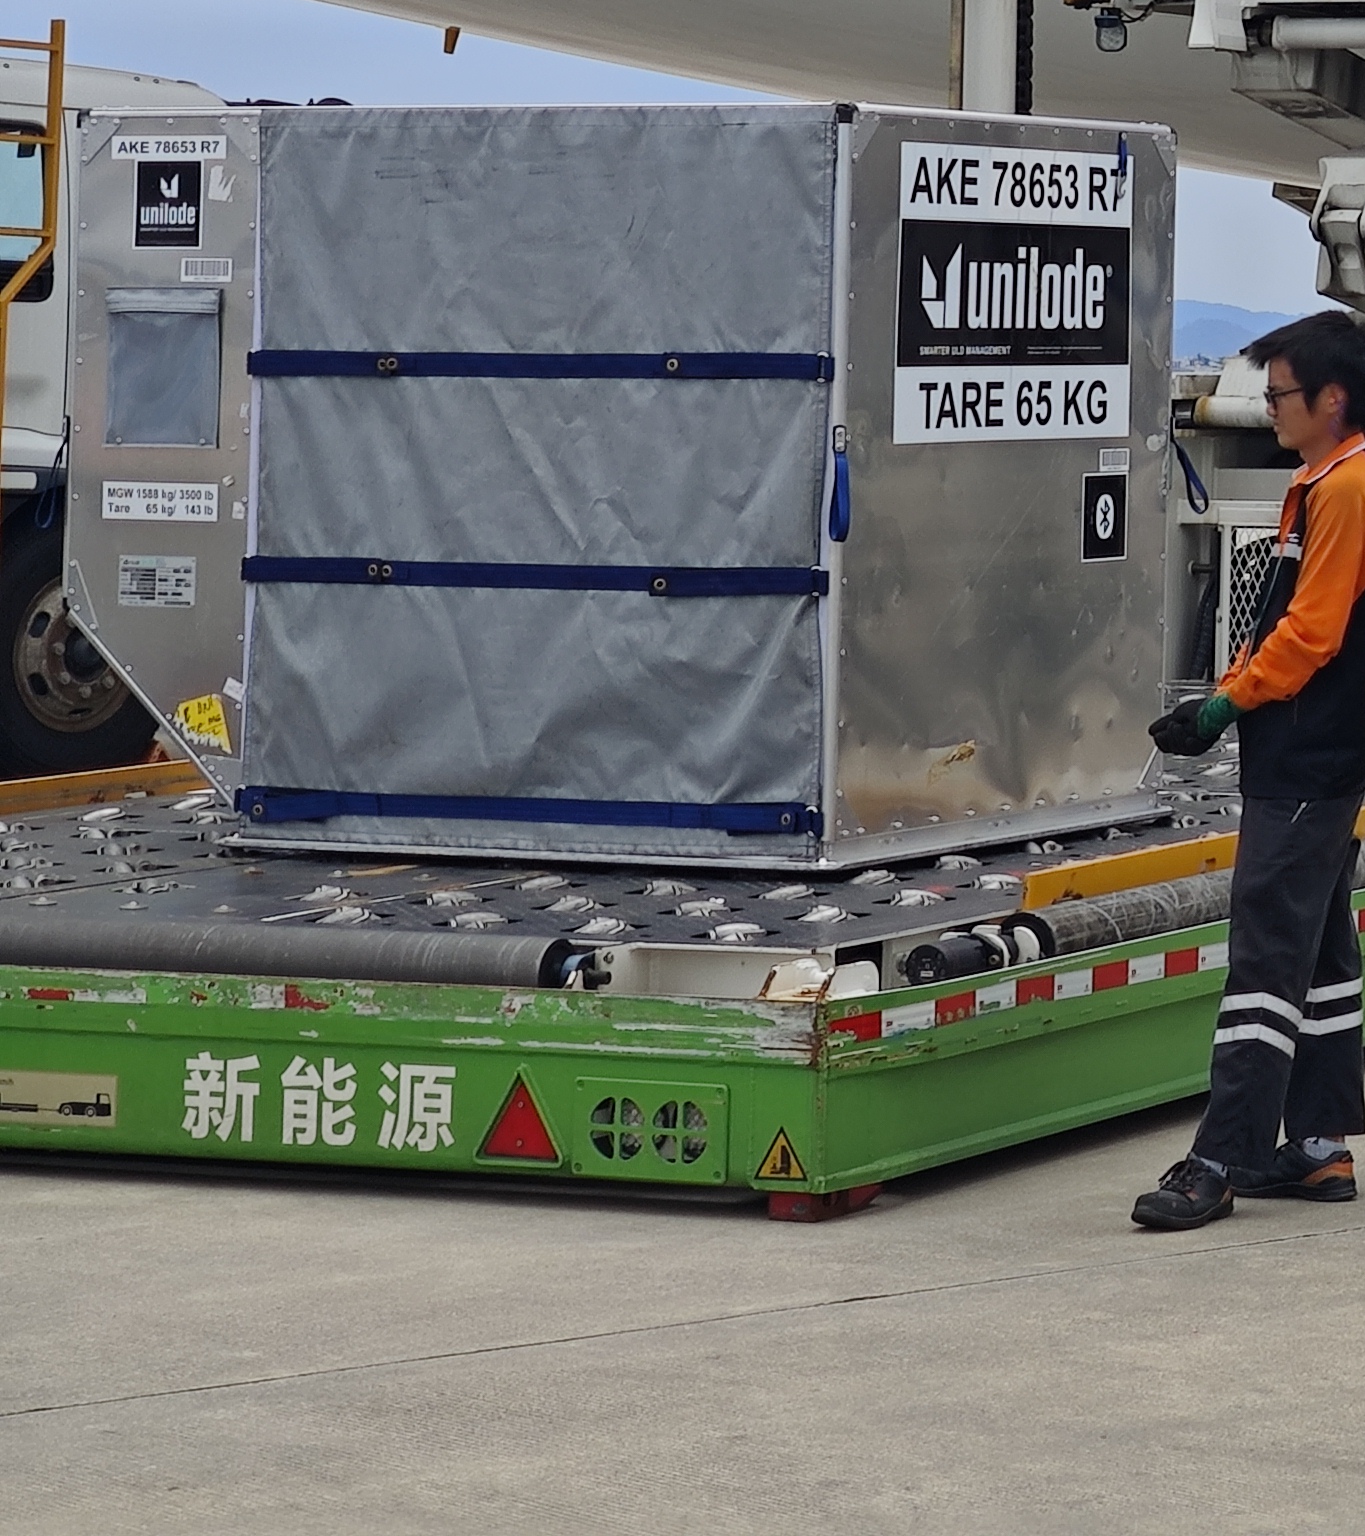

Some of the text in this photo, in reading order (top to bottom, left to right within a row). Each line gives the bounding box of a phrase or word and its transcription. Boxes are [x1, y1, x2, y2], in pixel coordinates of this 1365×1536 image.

[117, 140, 220, 154] AKE 78653 R7
[910, 155, 979, 206] AKE
[992, 161, 1080, 211] 78653
[140, 202, 197, 225] unilode
[967, 246, 1105, 331] unilode
[918, 379, 1109, 430] TARE 65 KG
[107, 487, 134, 499] MGW
[179, 489, 202, 501] 3500
[107, 502, 131, 513] Tare
[145, 503, 158, 514] 65
[184, 504, 202, 515] 143
[181, 1050, 457, 1153] 新能源
